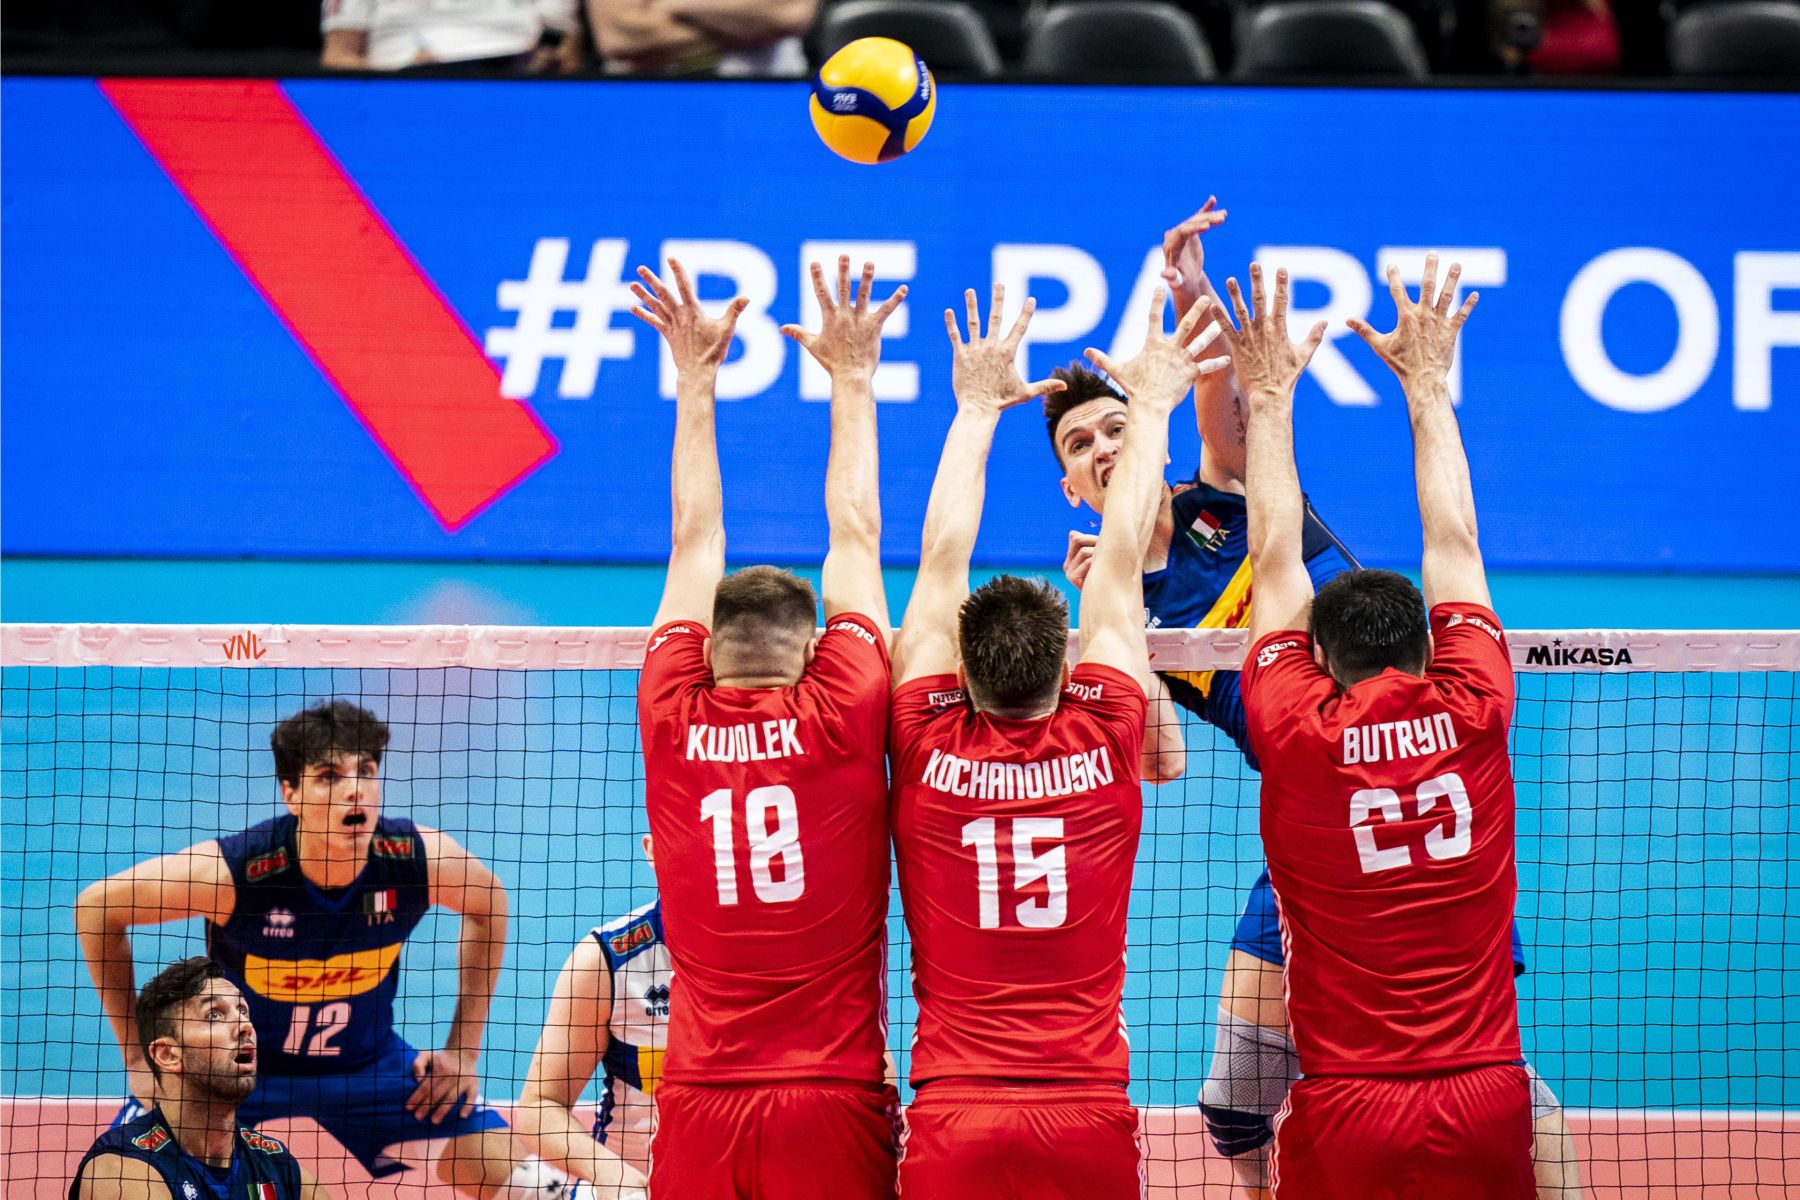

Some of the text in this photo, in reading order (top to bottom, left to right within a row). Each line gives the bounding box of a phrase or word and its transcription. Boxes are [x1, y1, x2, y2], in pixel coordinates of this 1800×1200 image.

[484, 237, 920, 402] #BE
[1558, 246, 1800, 413] OF
[1205, 528, 1231, 552] ITA
[222, 630, 267, 660] VNL
[1065, 682, 1104, 700] plus
[686, 718, 805, 763] KWOLEK
[1343, 711, 1459, 765] BUTRYN
[921, 746, 1115, 800] KOCHANOWSKI
[700, 784, 806, 906] 18
[1349, 772, 1473, 873] 23
[961, 816, 1068, 929] 15
[367, 911, 395, 927] ITA
[280, 967, 368, 990] DHL
[282, 1001, 352, 1056] 12
[645, 1005, 670, 1017] erre
